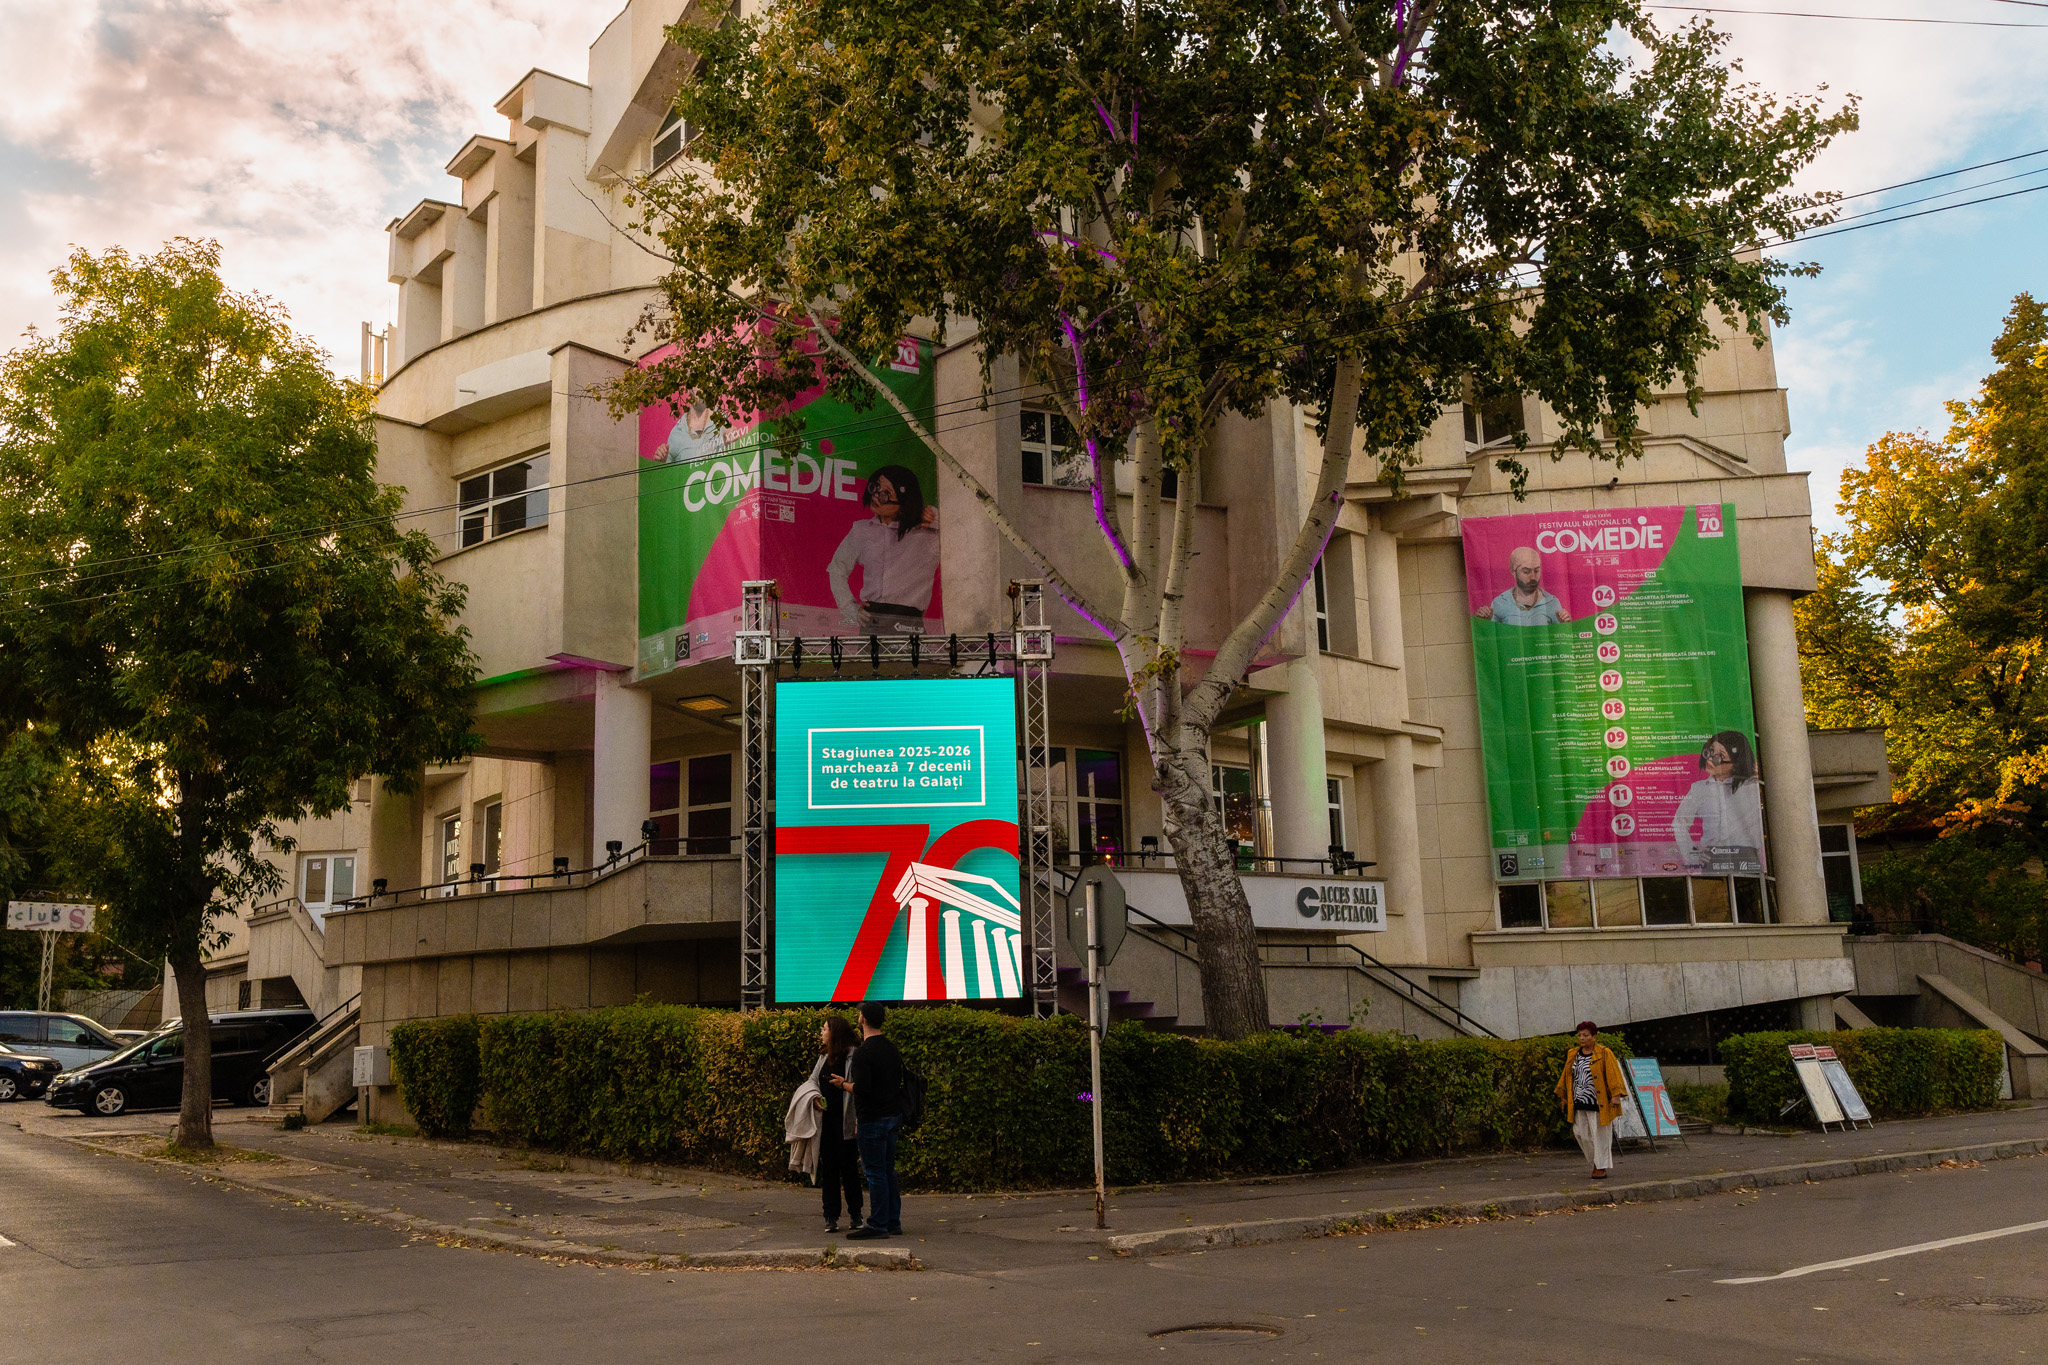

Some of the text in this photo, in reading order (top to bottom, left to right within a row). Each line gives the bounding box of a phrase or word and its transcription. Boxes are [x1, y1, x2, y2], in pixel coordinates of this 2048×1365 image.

[724, 426, 748, 442] XXXVI
[683, 439, 858, 513] COMEDIE
[1582, 519, 1620, 528] NAȚIONAL
[1699, 517, 1720, 531] 70
[1536, 516, 1663, 553] COMEDIE
[1595, 590, 1613, 601] 04
[1598, 618, 1615, 629] 05
[1599, 646, 1618, 657] 06
[1602, 674, 1620, 685] 07
[1604, 703, 1622, 714] 08
[1607, 731, 1625, 742] 09
[822, 746, 970, 761] Stagiunea 2025-2026
[822, 760, 971, 774] marchează 7 decenii
[1610, 760, 1626, 771] 10
[830, 775, 962, 790] de teatru la Galați
[1613, 789, 1627, 800] 11
[1615, 818, 1631, 830] 12
[1320, 886, 1377, 905] ACCES SALĂ
[69, 908, 86, 929] S
[1321, 904, 1378, 923] SPECTACOL
[1637, 1085, 1677, 1136] 70
